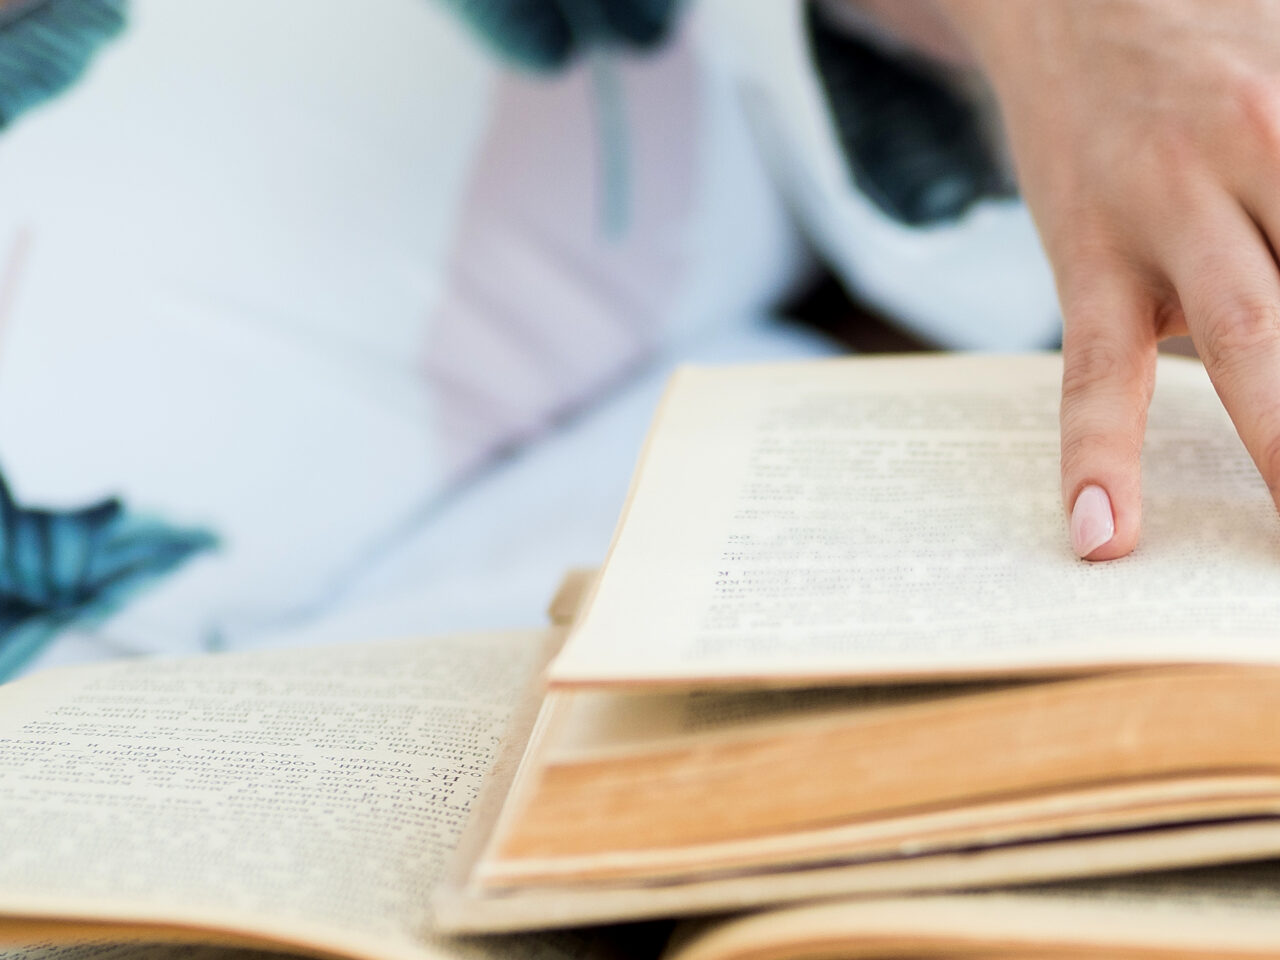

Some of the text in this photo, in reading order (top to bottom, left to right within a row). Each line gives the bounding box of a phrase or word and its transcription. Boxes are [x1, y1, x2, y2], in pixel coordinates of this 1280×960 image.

[92, 748, 156, 757] барин
[201, 747, 303, 758] засудить,
[313, 743, 374, 751] среди
[387, 747, 463, 761] вечера,
[175, 753, 316, 767] собственник,
[319, 754, 411, 767] продать,
[157, 764, 274, 777] свободные
[222, 762, 358, 776] достоинстве
[332, 762, 412, 774] хозяин,
[319, 775, 377, 784] люди
[369, 772, 431, 783] своем
[427, 772, 459, 782] Их
[386, 781, 419, 789] это
[432, 786, 453, 794] но
[391, 787, 447, 802] Идут
